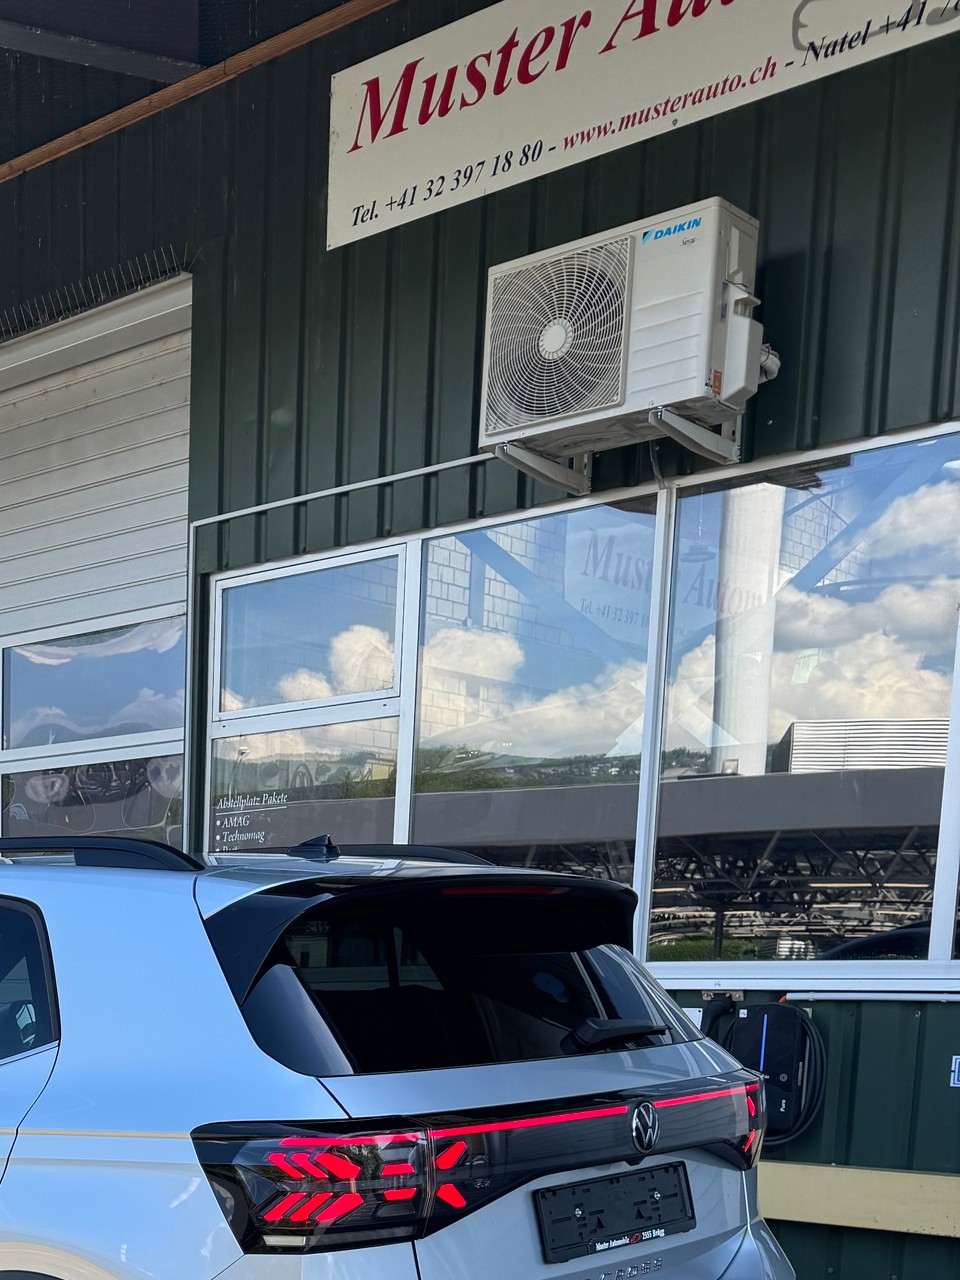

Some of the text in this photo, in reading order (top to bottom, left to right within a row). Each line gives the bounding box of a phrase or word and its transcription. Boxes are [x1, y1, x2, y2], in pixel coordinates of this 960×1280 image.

[346, 0, 734, 154] Muster Au
[352, 200, 379, 227] Tel.
[385, 185, 418, 212] +41
[423, 175, 445, 202] 32
[450, 160, 486, 192] 397
[490, 150, 514, 177] 18
[519, 139, 543, 167] 80
[563, 55, 778, 150] www.musterauto.ch
[801, 19, 872, 67] Natel
[878, 0, 928, 35] +41
[653, 217, 702, 241] DAIKIN
[216, 792, 288, 810] Abstellplatz Pakete
[222, 815, 250, 828] AMAG
[223, 830, 265, 843] Technomag
